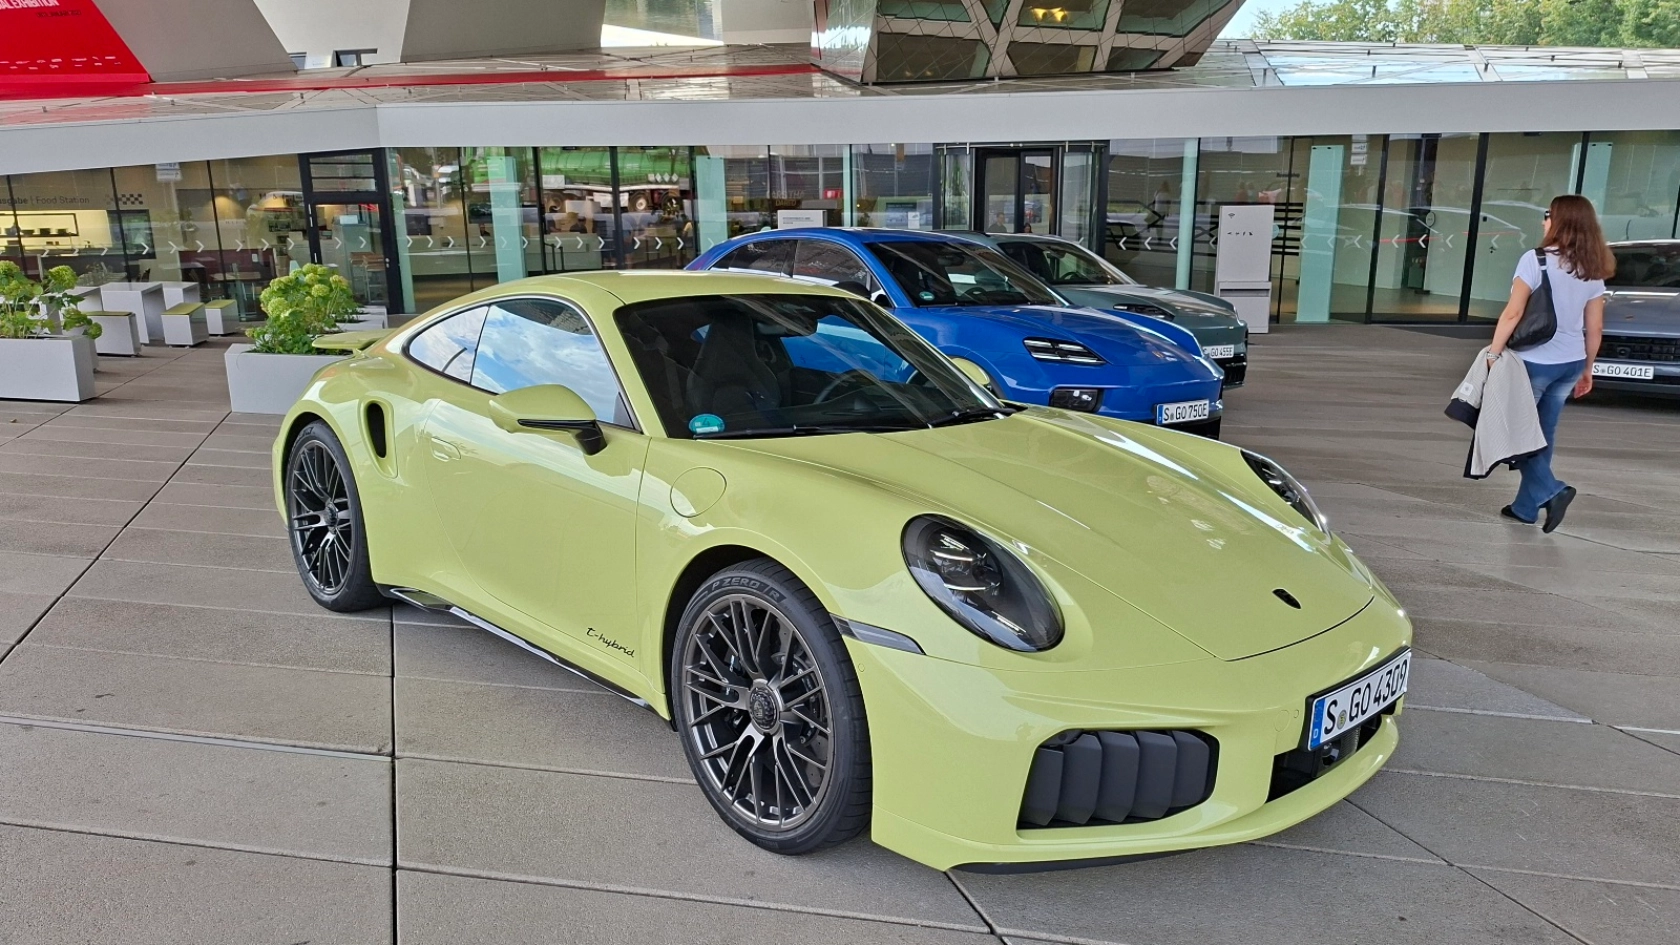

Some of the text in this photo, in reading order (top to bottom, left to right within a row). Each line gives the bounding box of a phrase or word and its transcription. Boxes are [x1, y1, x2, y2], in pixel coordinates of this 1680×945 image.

[36, 196, 58, 204] Food
[60, 196, 90, 204] Station
[1593, 364, 1652, 378] S GO 401E
[1163, 407, 1170, 421] S
[1175, 405, 1188, 420] GO
[1188, 402, 1208, 418] 750E
[711, 577, 780, 601] P ZERO R
[586, 627, 635, 658] t-hybrid
[1313, 659, 1408, 739] D S GO 4309
